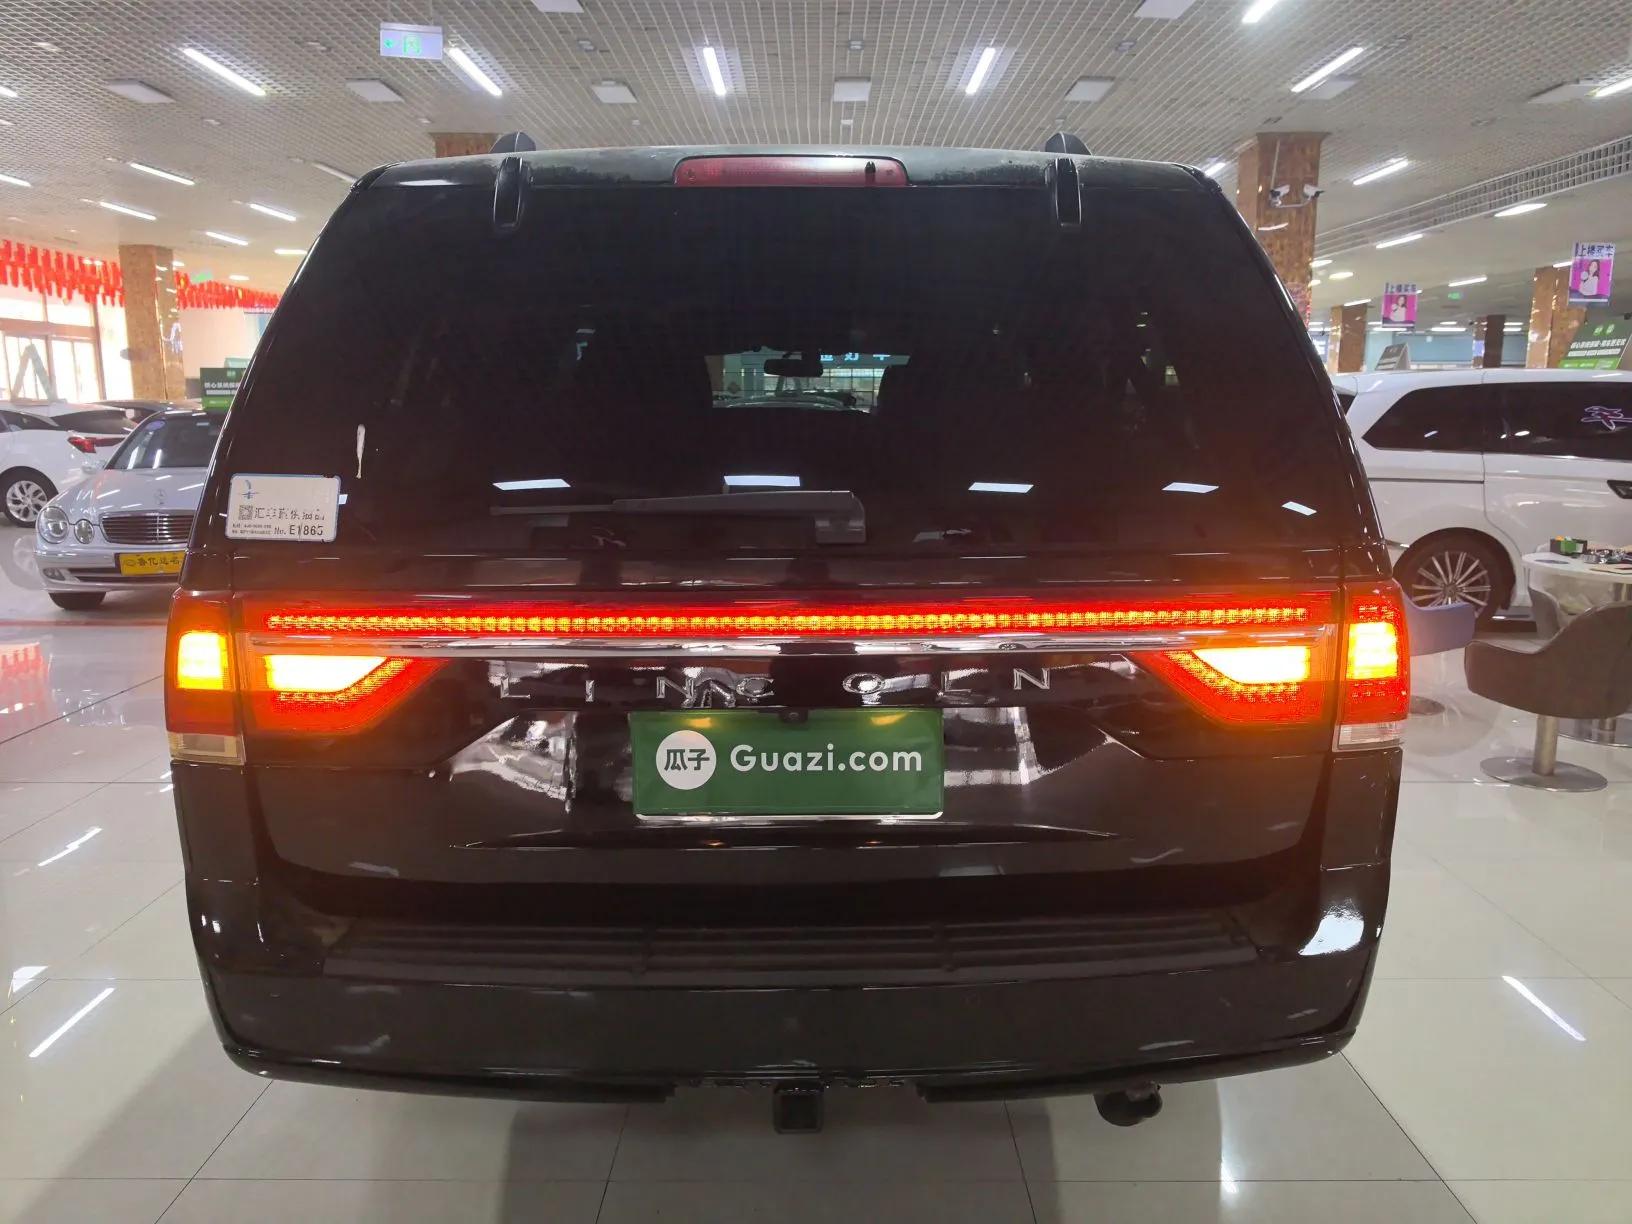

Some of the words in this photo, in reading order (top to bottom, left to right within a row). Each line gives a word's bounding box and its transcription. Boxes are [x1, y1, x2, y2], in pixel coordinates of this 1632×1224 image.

[500, 667, 1050, 702] LINCOLN
[664, 748, 710, 771] 瓜子
[730, 743, 922, 772] Guazi.com
